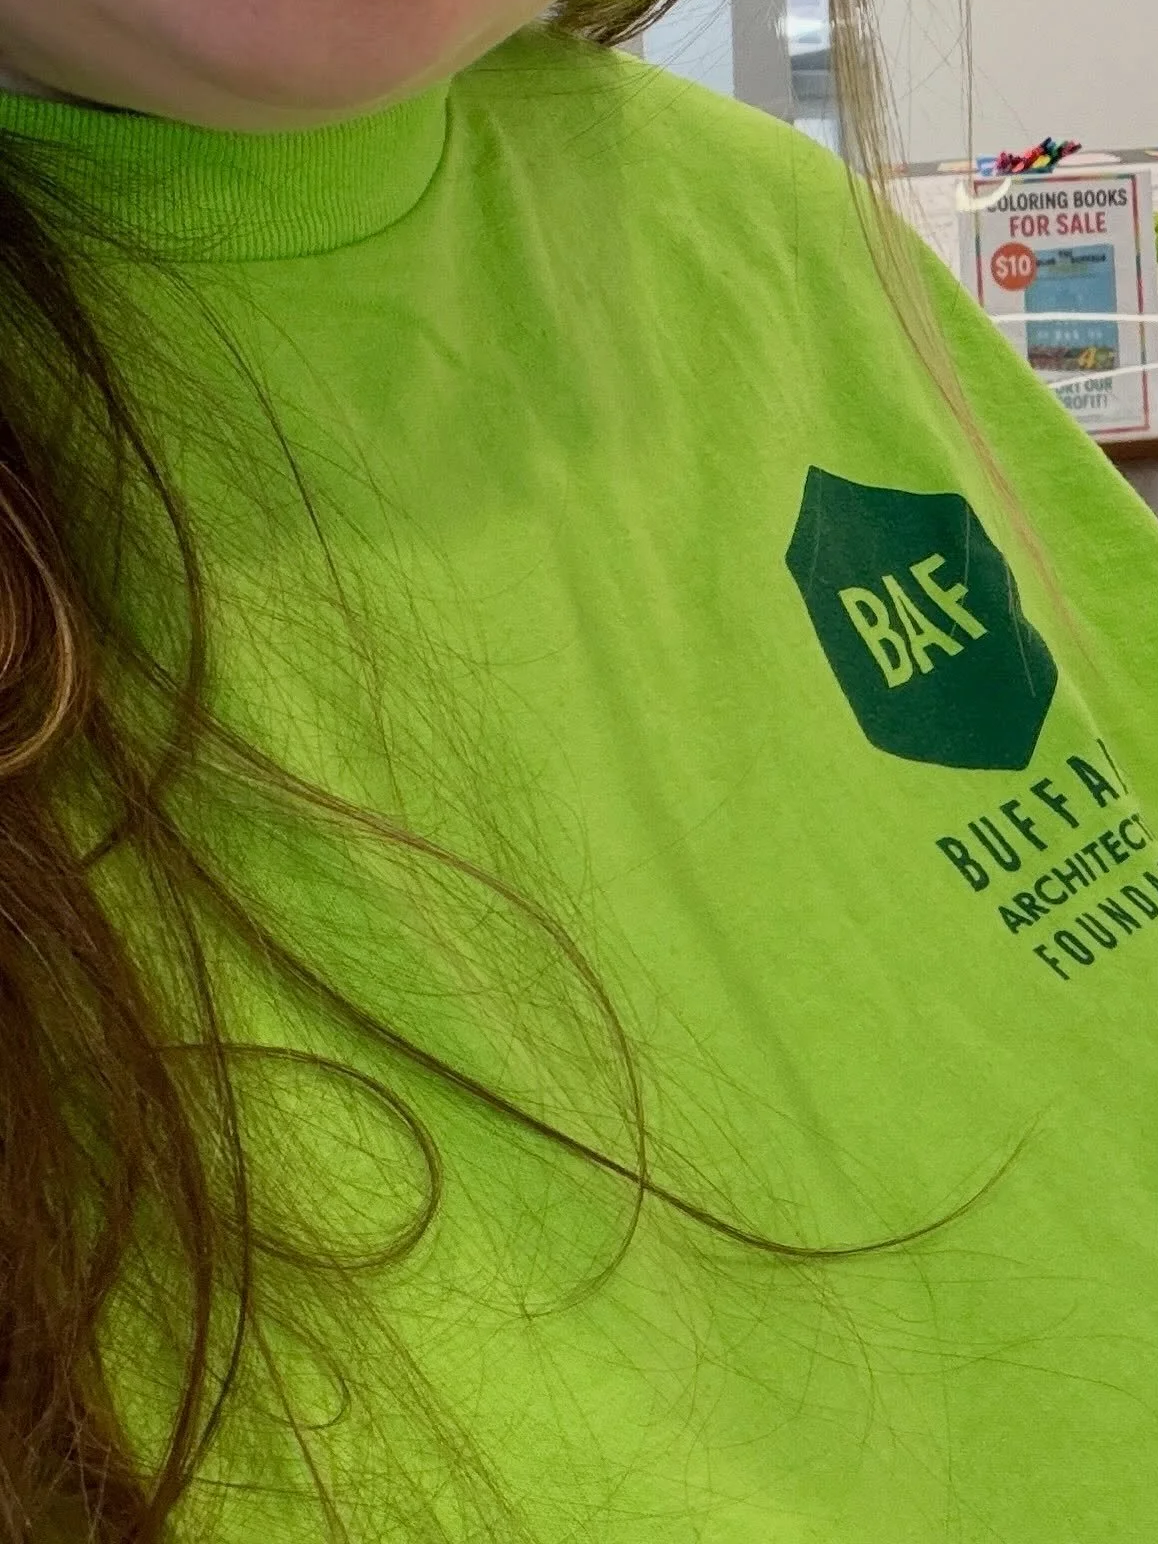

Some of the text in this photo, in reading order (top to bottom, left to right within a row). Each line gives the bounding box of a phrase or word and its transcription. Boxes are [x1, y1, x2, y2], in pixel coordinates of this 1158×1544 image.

[1073, 188, 1127, 208] BOOKS
[1009, 211, 1107, 237] FOR SALE
[994, 253, 1032, 279] $10
[838, 553, 988, 689] BAF
[935, 738, 1129, 892] BUFFA
